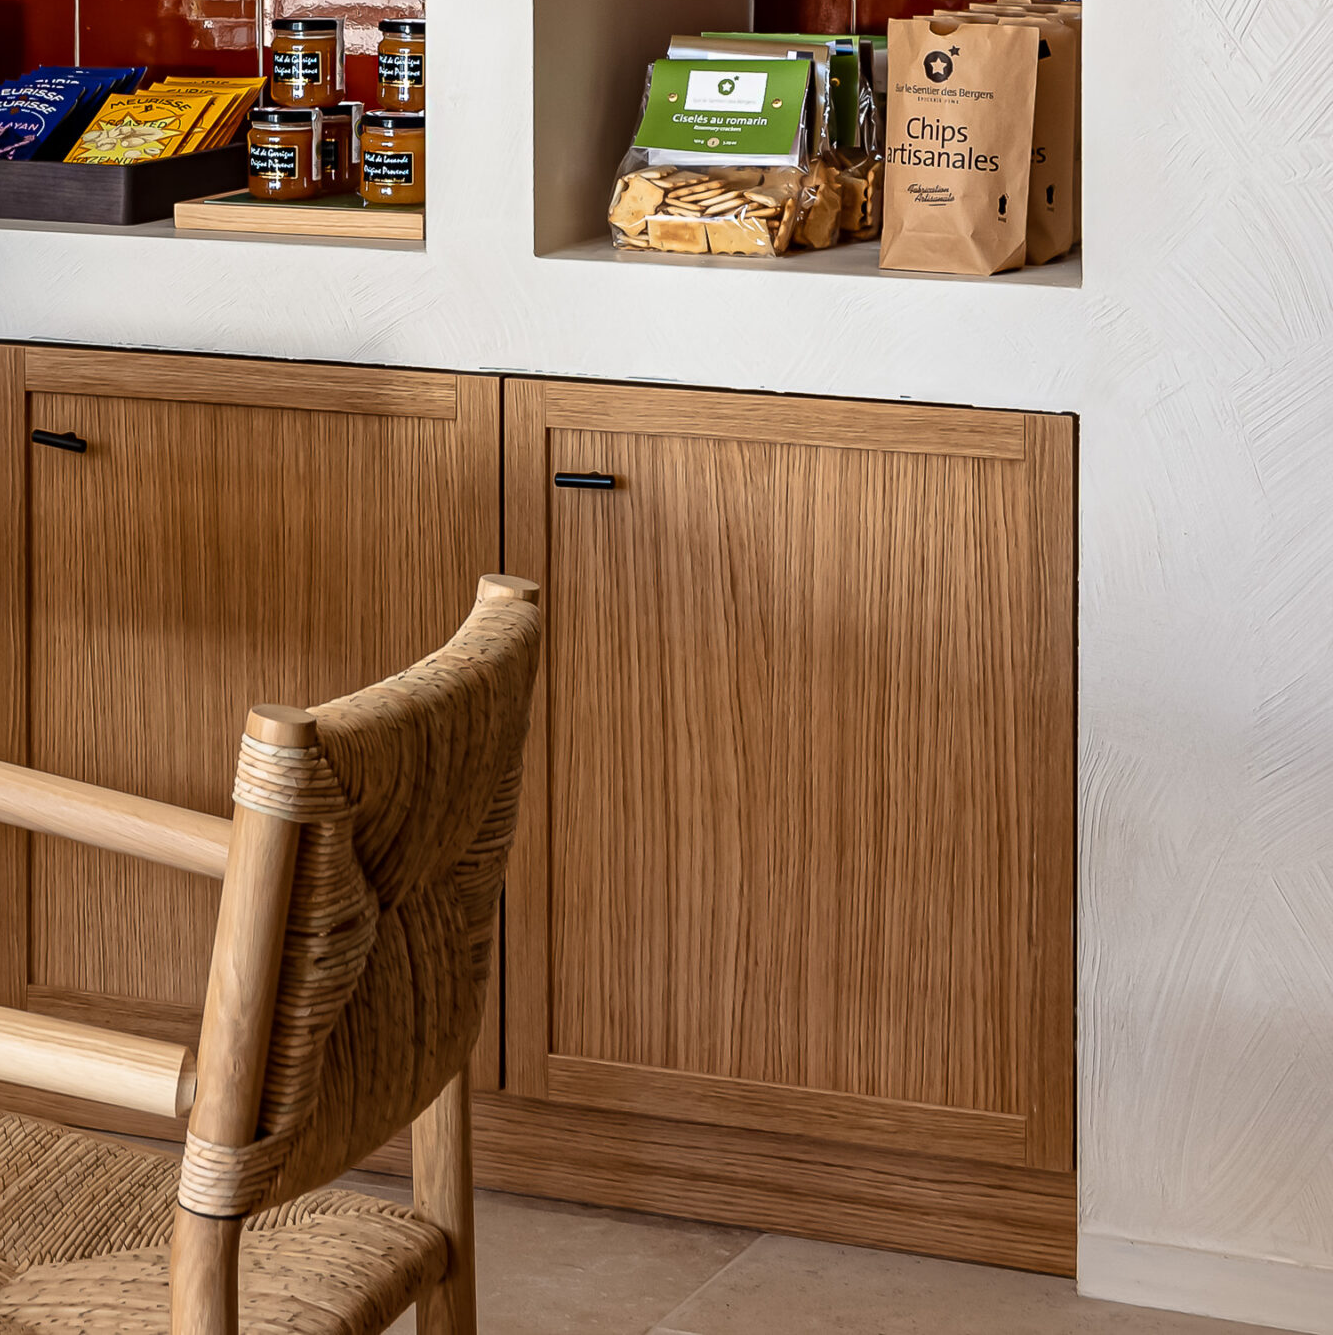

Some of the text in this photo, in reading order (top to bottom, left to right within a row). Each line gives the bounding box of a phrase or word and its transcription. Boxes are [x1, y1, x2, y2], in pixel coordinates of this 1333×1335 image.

[292, 65, 318, 75] Prvence
[395, 67, 421, 77] Proence
[912, 85, 940, 95] Sentier
[940, 87, 957, 96] des
[958, 88, 994, 101] Bergers
[110, 98, 192, 112] MEURISSE
[106, 119, 168, 129] ROASTED
[672, 113, 768, 126] Ciselés au romarin
[906, 116, 969, 149] Chips
[887, 142, 999, 172] artisanales
